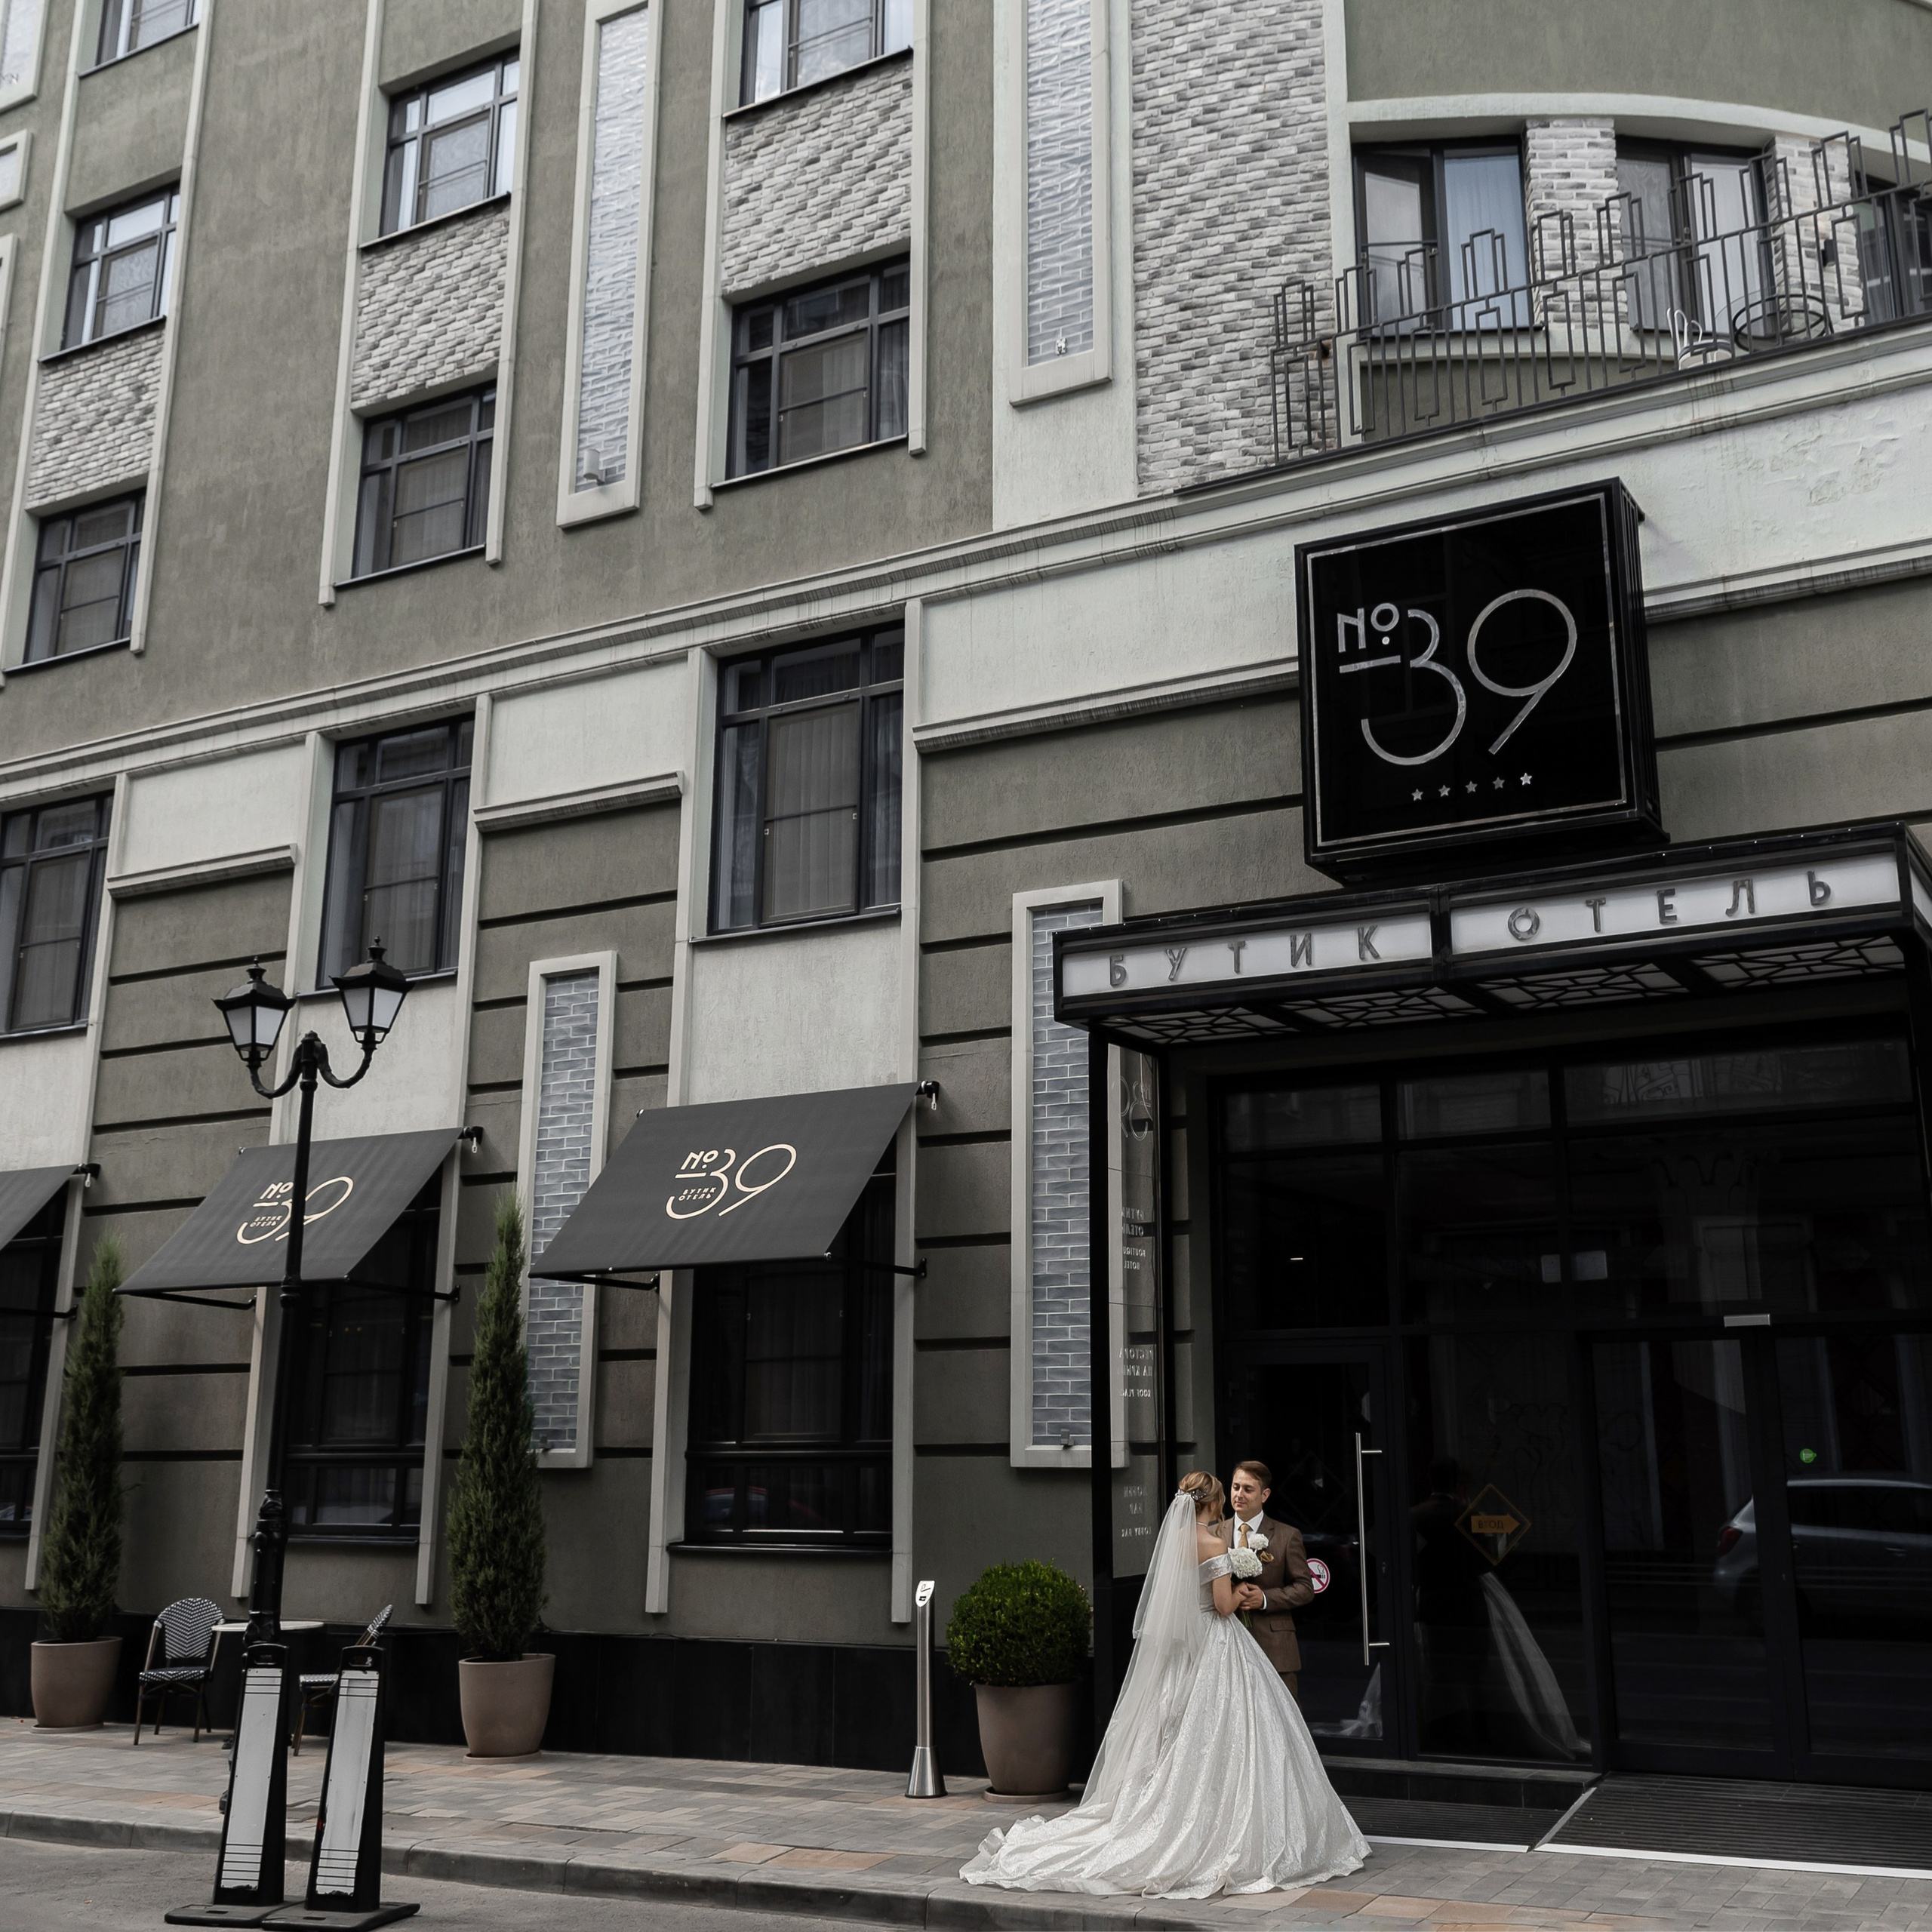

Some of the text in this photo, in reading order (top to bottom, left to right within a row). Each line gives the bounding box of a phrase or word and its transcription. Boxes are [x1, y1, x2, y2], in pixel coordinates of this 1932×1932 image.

[1361, 588, 1578, 766] 39
[1108, 869, 1832, 988] БУТИК ОТЕЛЬ
[665, 1143, 798, 1220] 39
[678, 1193, 712, 1201] ОТЕЛЬ
[682, 1186, 717, 1195] БУТИК
[1478, 1519, 1505, 1530] ВХОД
